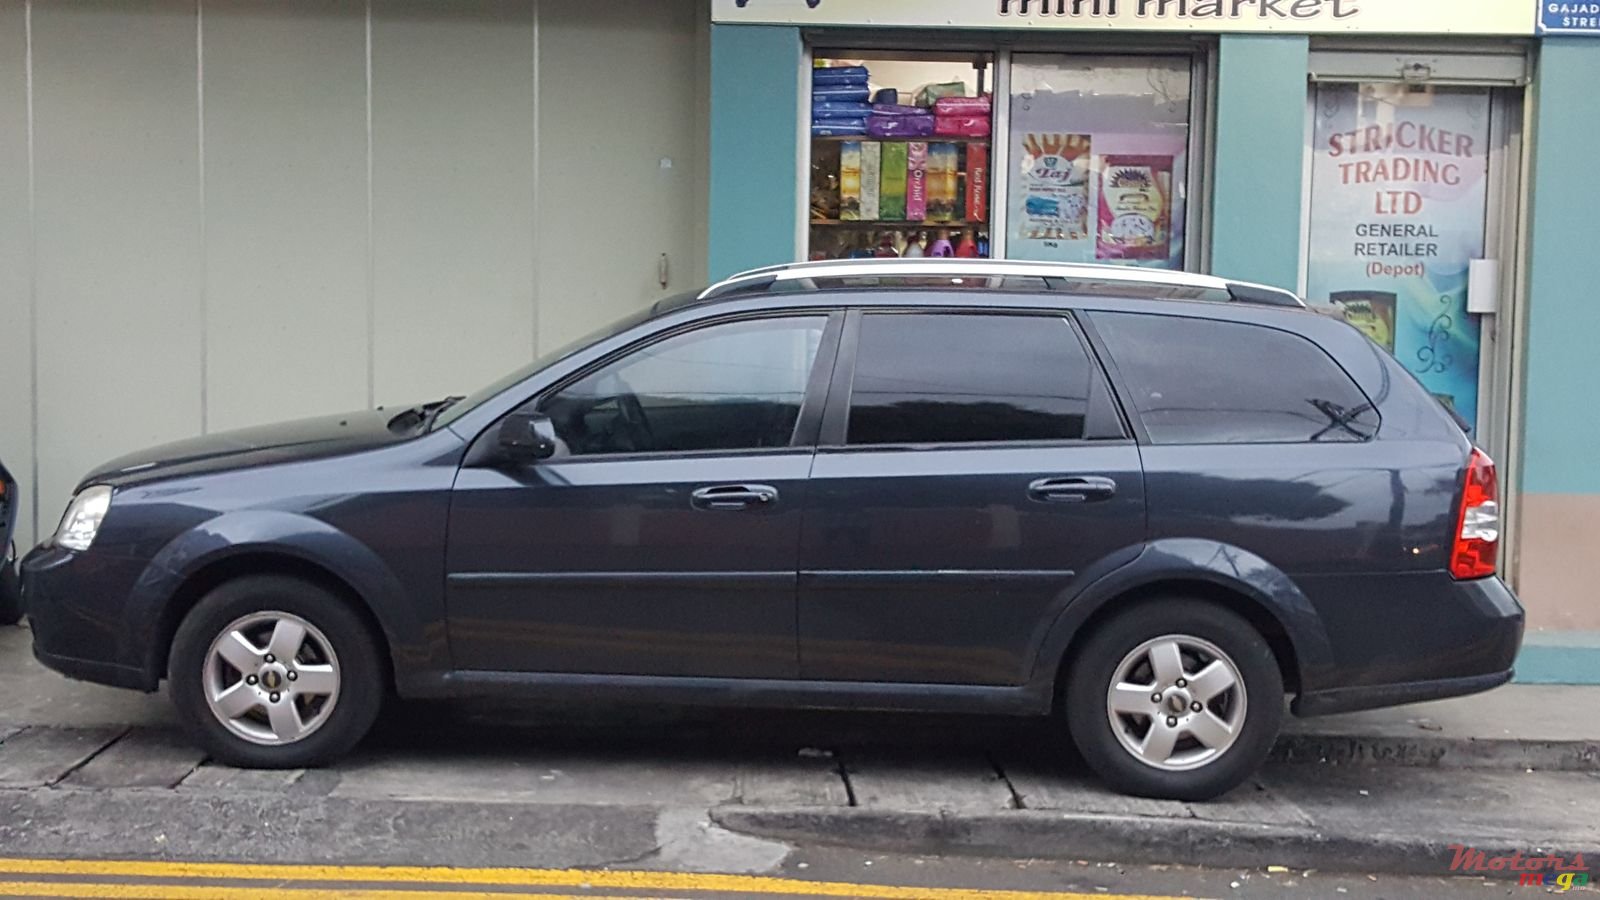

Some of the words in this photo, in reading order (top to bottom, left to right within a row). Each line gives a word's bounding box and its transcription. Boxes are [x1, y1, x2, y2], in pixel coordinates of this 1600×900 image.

[1138, 0, 1359, 18] market
[1562, 16, 1600, 27] STRE
[1328, 121, 1474, 158] STRICKER
[1338, 157, 1460, 186] TRADING
[1375, 191, 1423, 215] LTD
[1355, 223, 1439, 238] GENERAL
[1354, 242, 1438, 257] RETAILER
[1365, 262, 1425, 278] (Depot)
